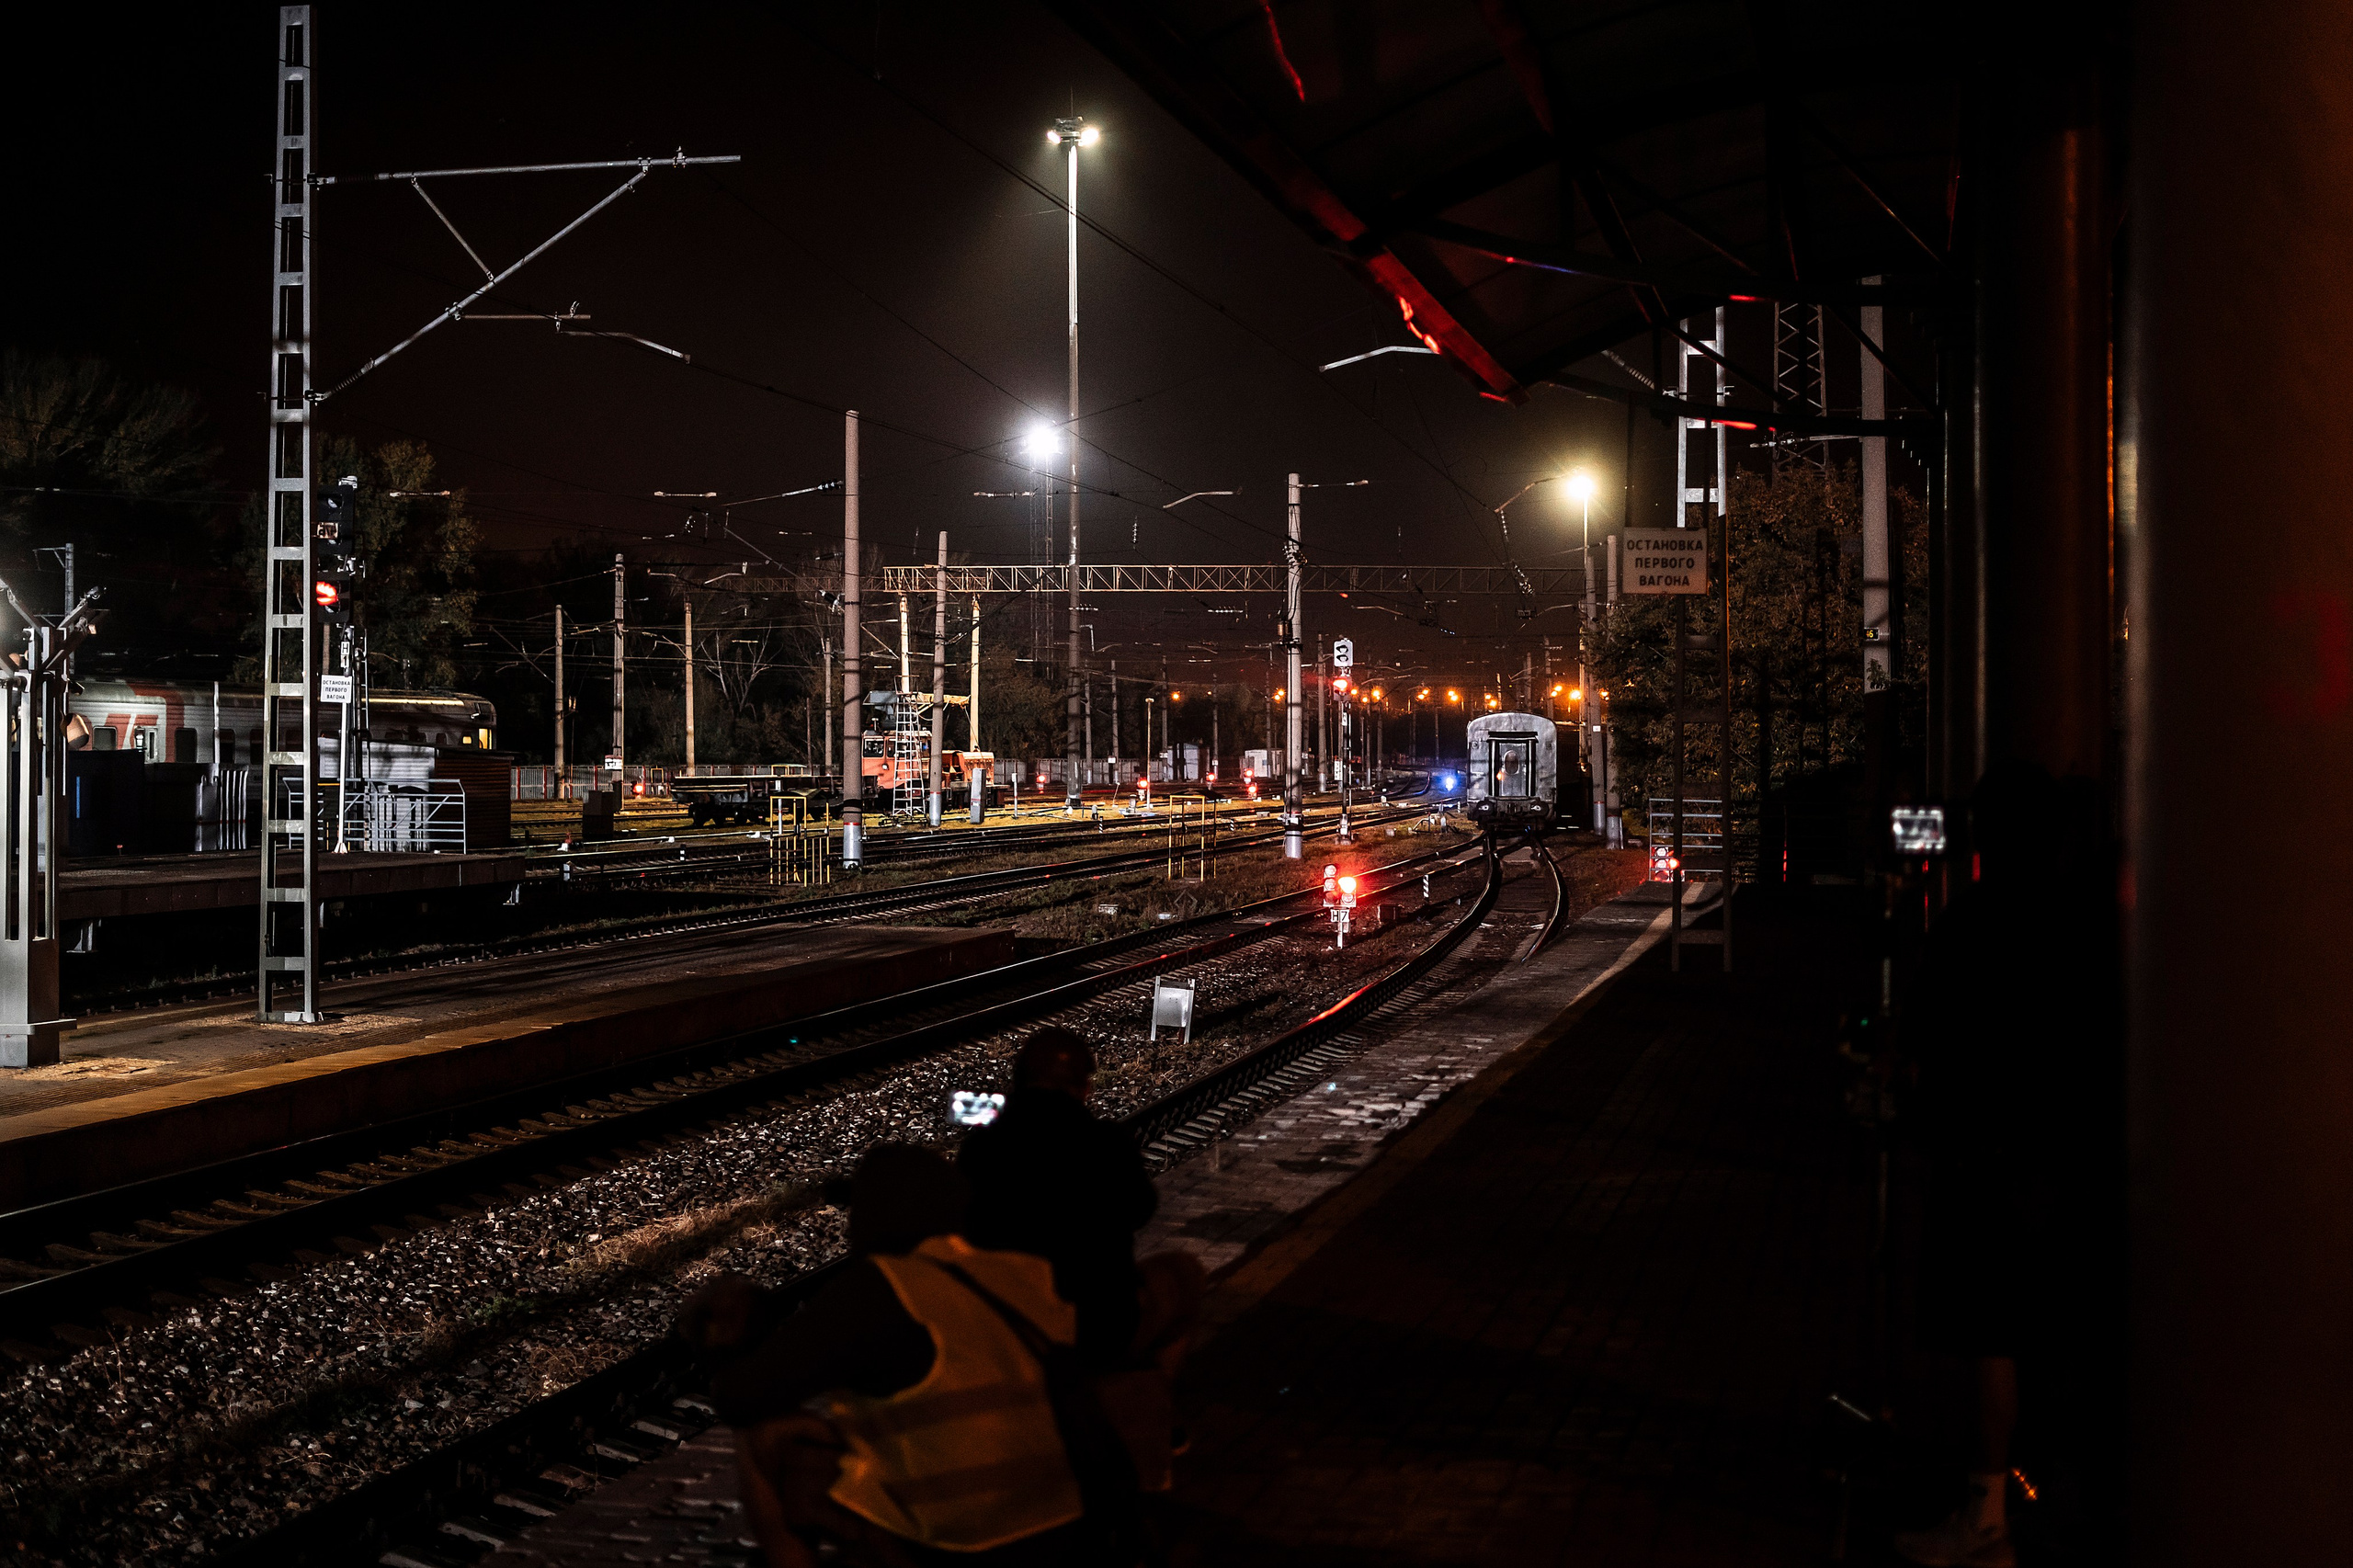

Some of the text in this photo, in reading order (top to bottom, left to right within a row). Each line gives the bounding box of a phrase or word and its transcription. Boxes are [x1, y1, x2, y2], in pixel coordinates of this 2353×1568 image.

[1627, 540, 1703, 551] ОСТАНОВКА
[1635, 557, 1695, 568] ПЕРВОГО
[1640, 575, 1689, 586] ВАГОНА
